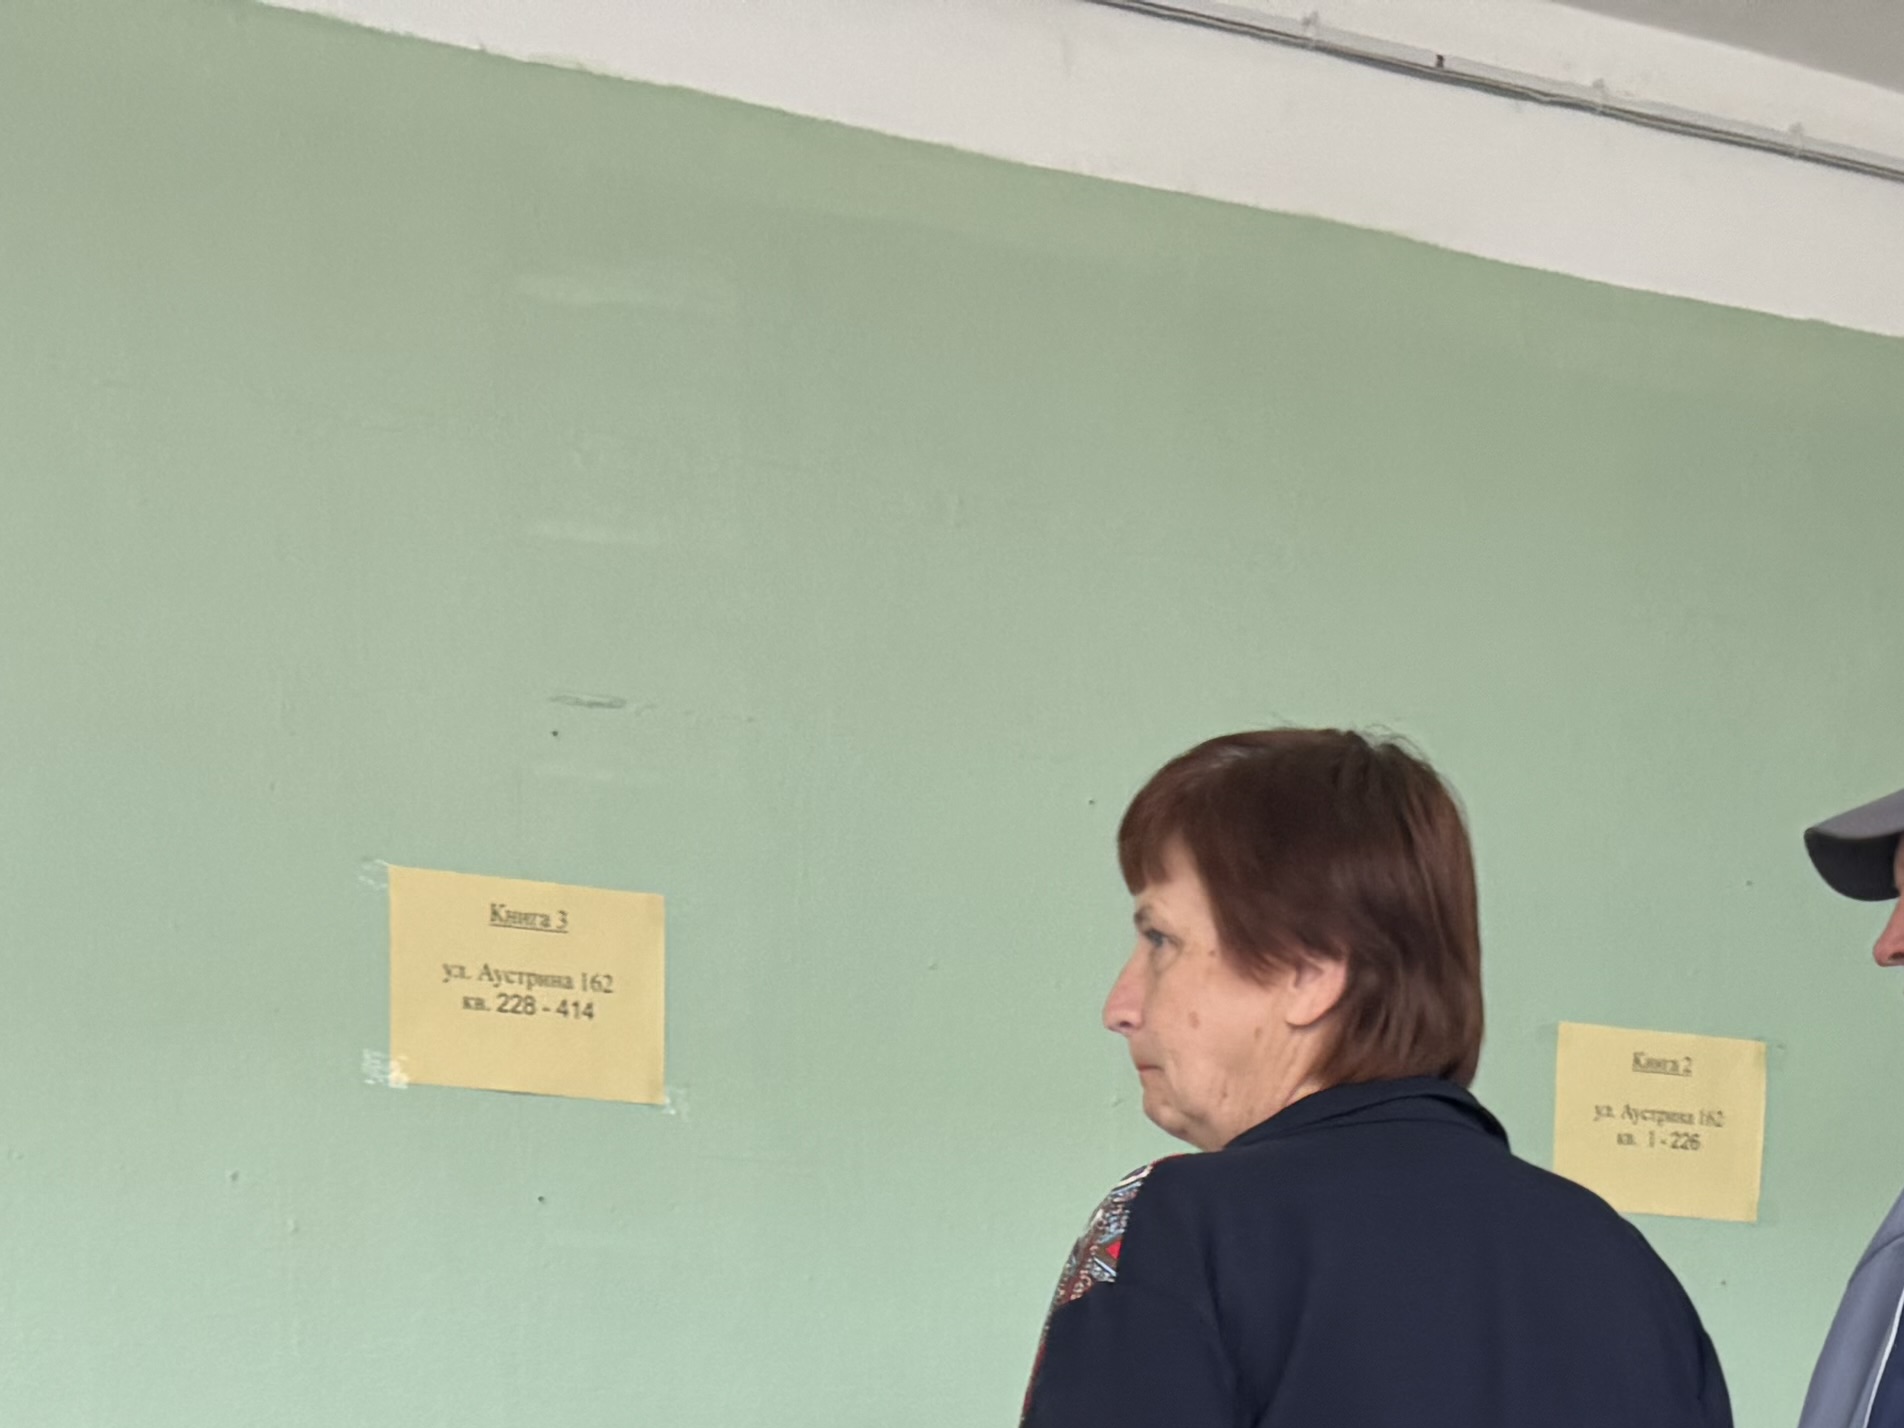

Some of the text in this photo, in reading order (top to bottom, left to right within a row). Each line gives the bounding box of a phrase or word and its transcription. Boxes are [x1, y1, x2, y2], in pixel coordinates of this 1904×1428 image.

[489, 902, 569, 930] Книга 3
[442, 962, 614, 994] ул. Аустрина 162
[461, 995, 492, 1012] кв.
[496, 992, 537, 1016] 228
[555, 998, 595, 1020] 414
[1632, 1051, 1693, 1076] Книга 2
